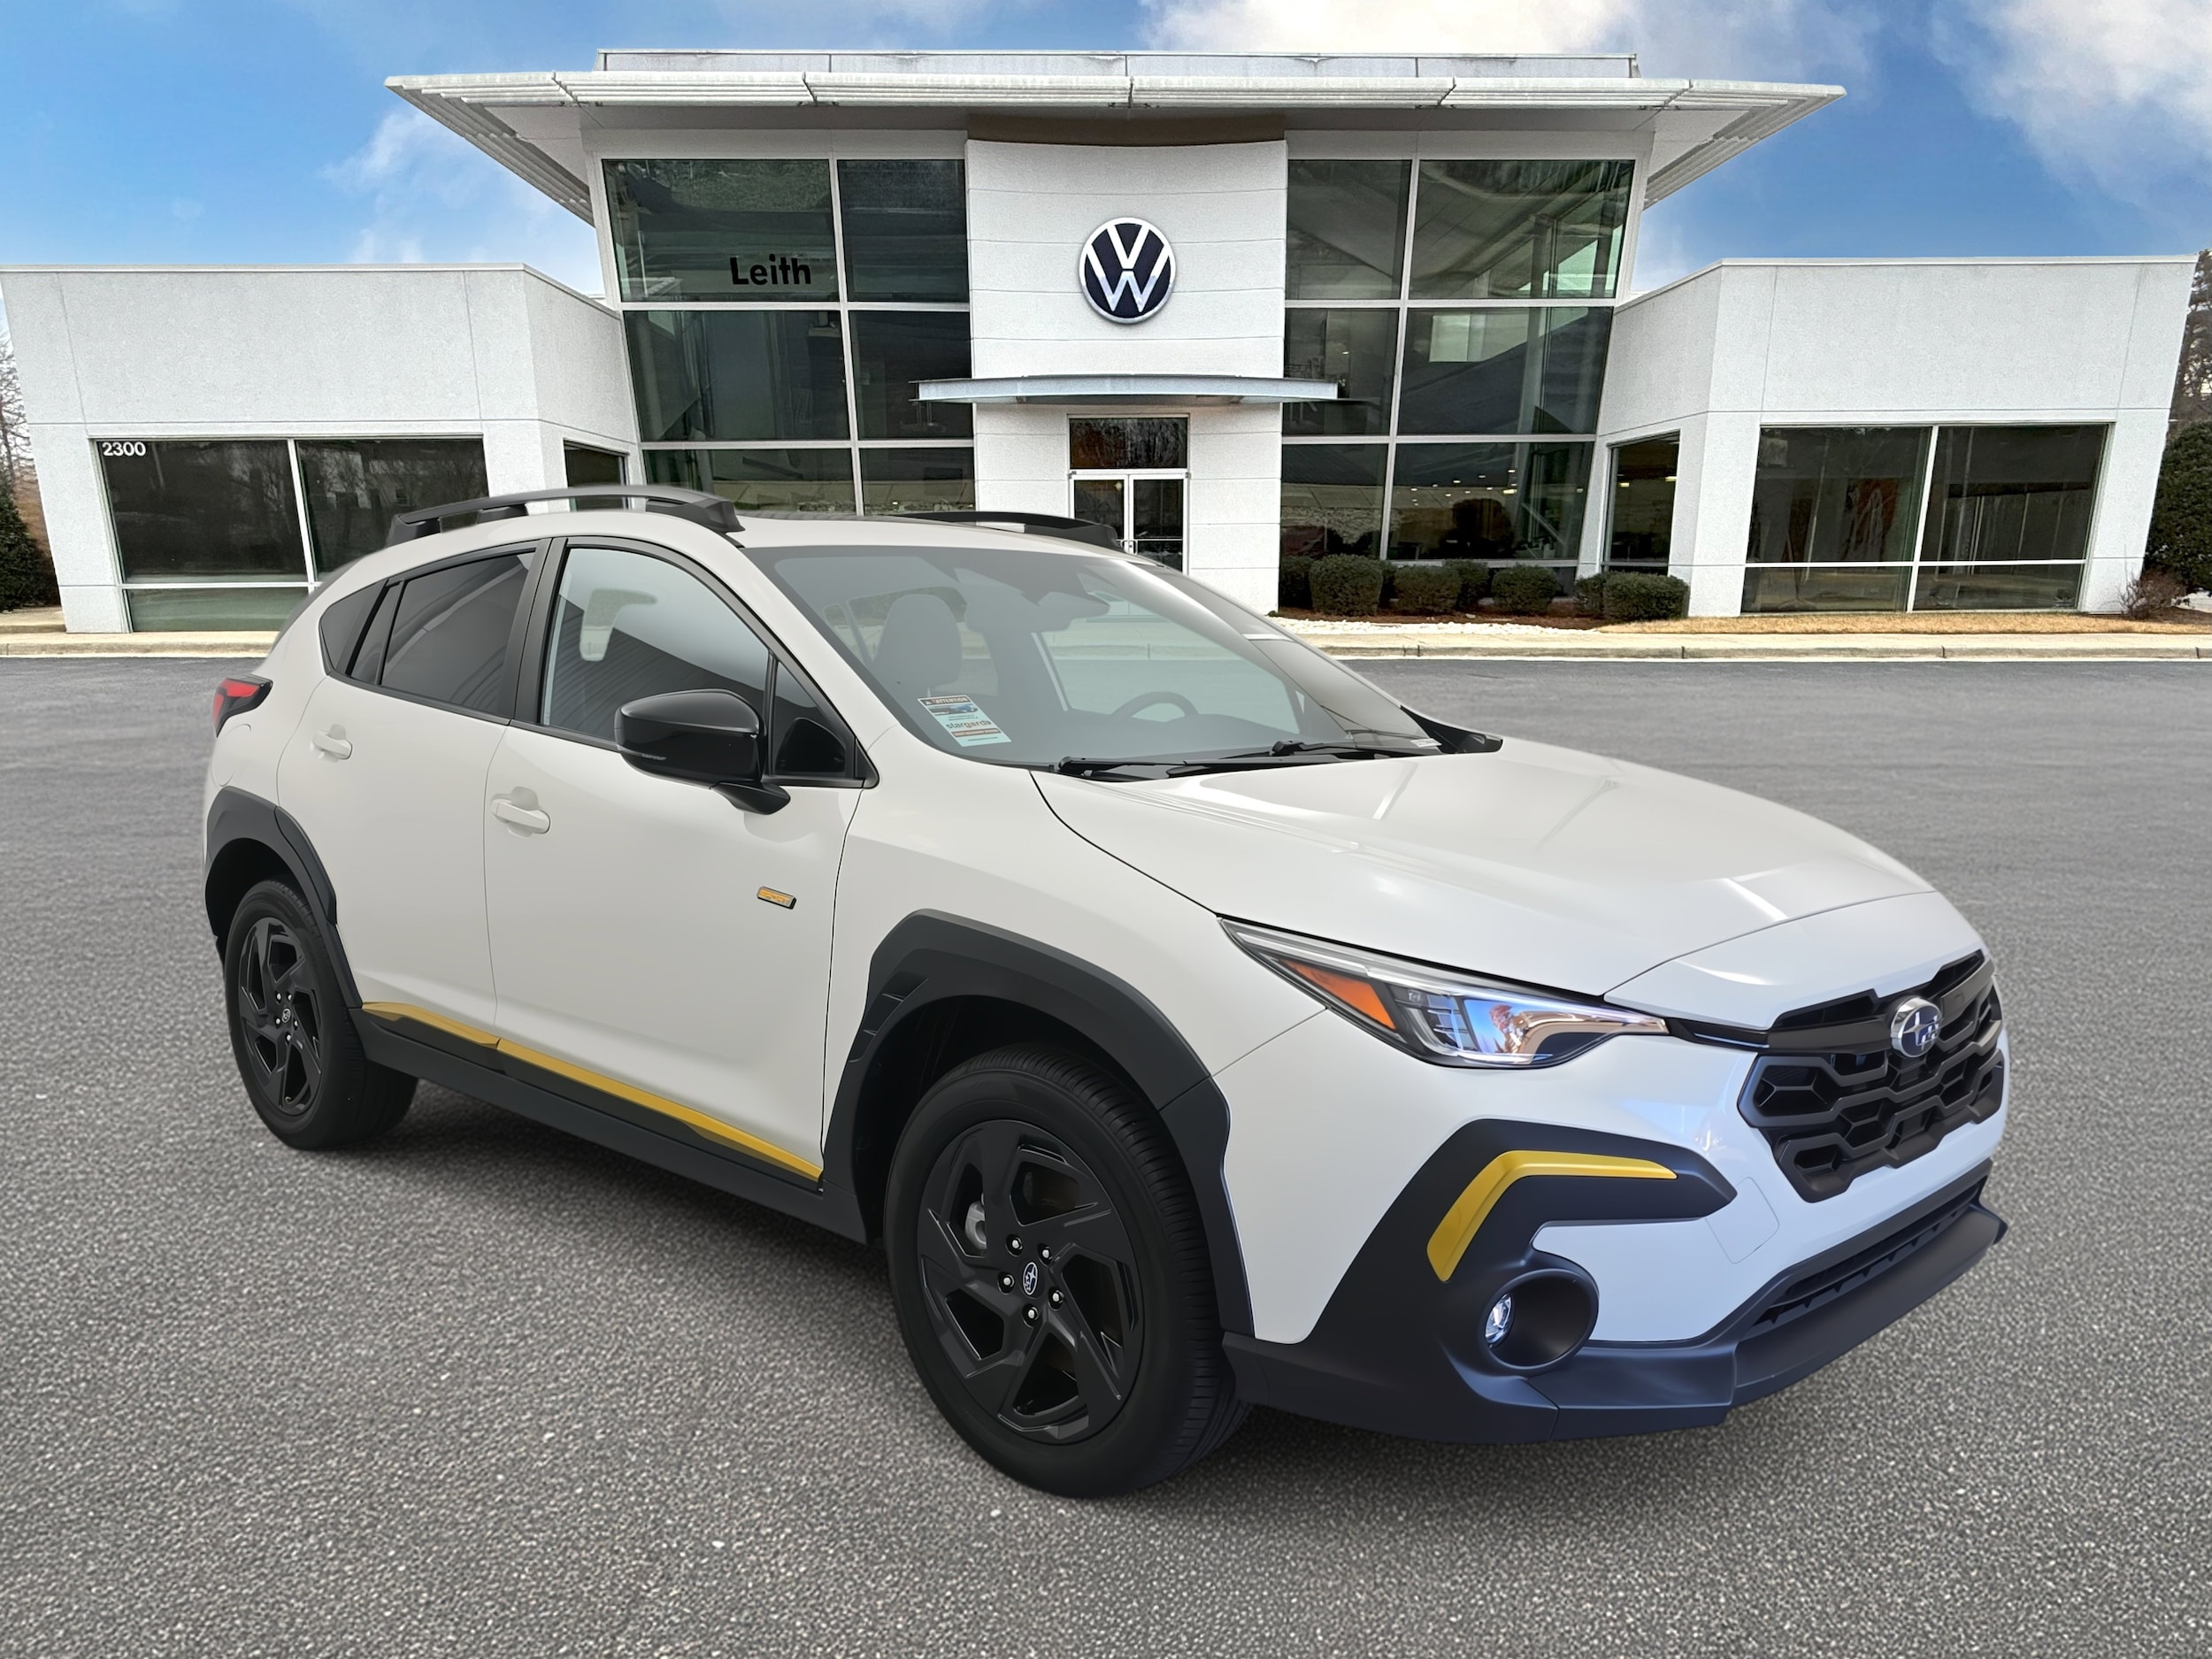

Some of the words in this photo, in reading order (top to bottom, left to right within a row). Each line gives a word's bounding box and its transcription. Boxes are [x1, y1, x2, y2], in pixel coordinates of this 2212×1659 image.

[730, 253, 811, 285] Leith
[1084, 220, 1171, 313] VW
[102, 442, 147, 457] 2300
